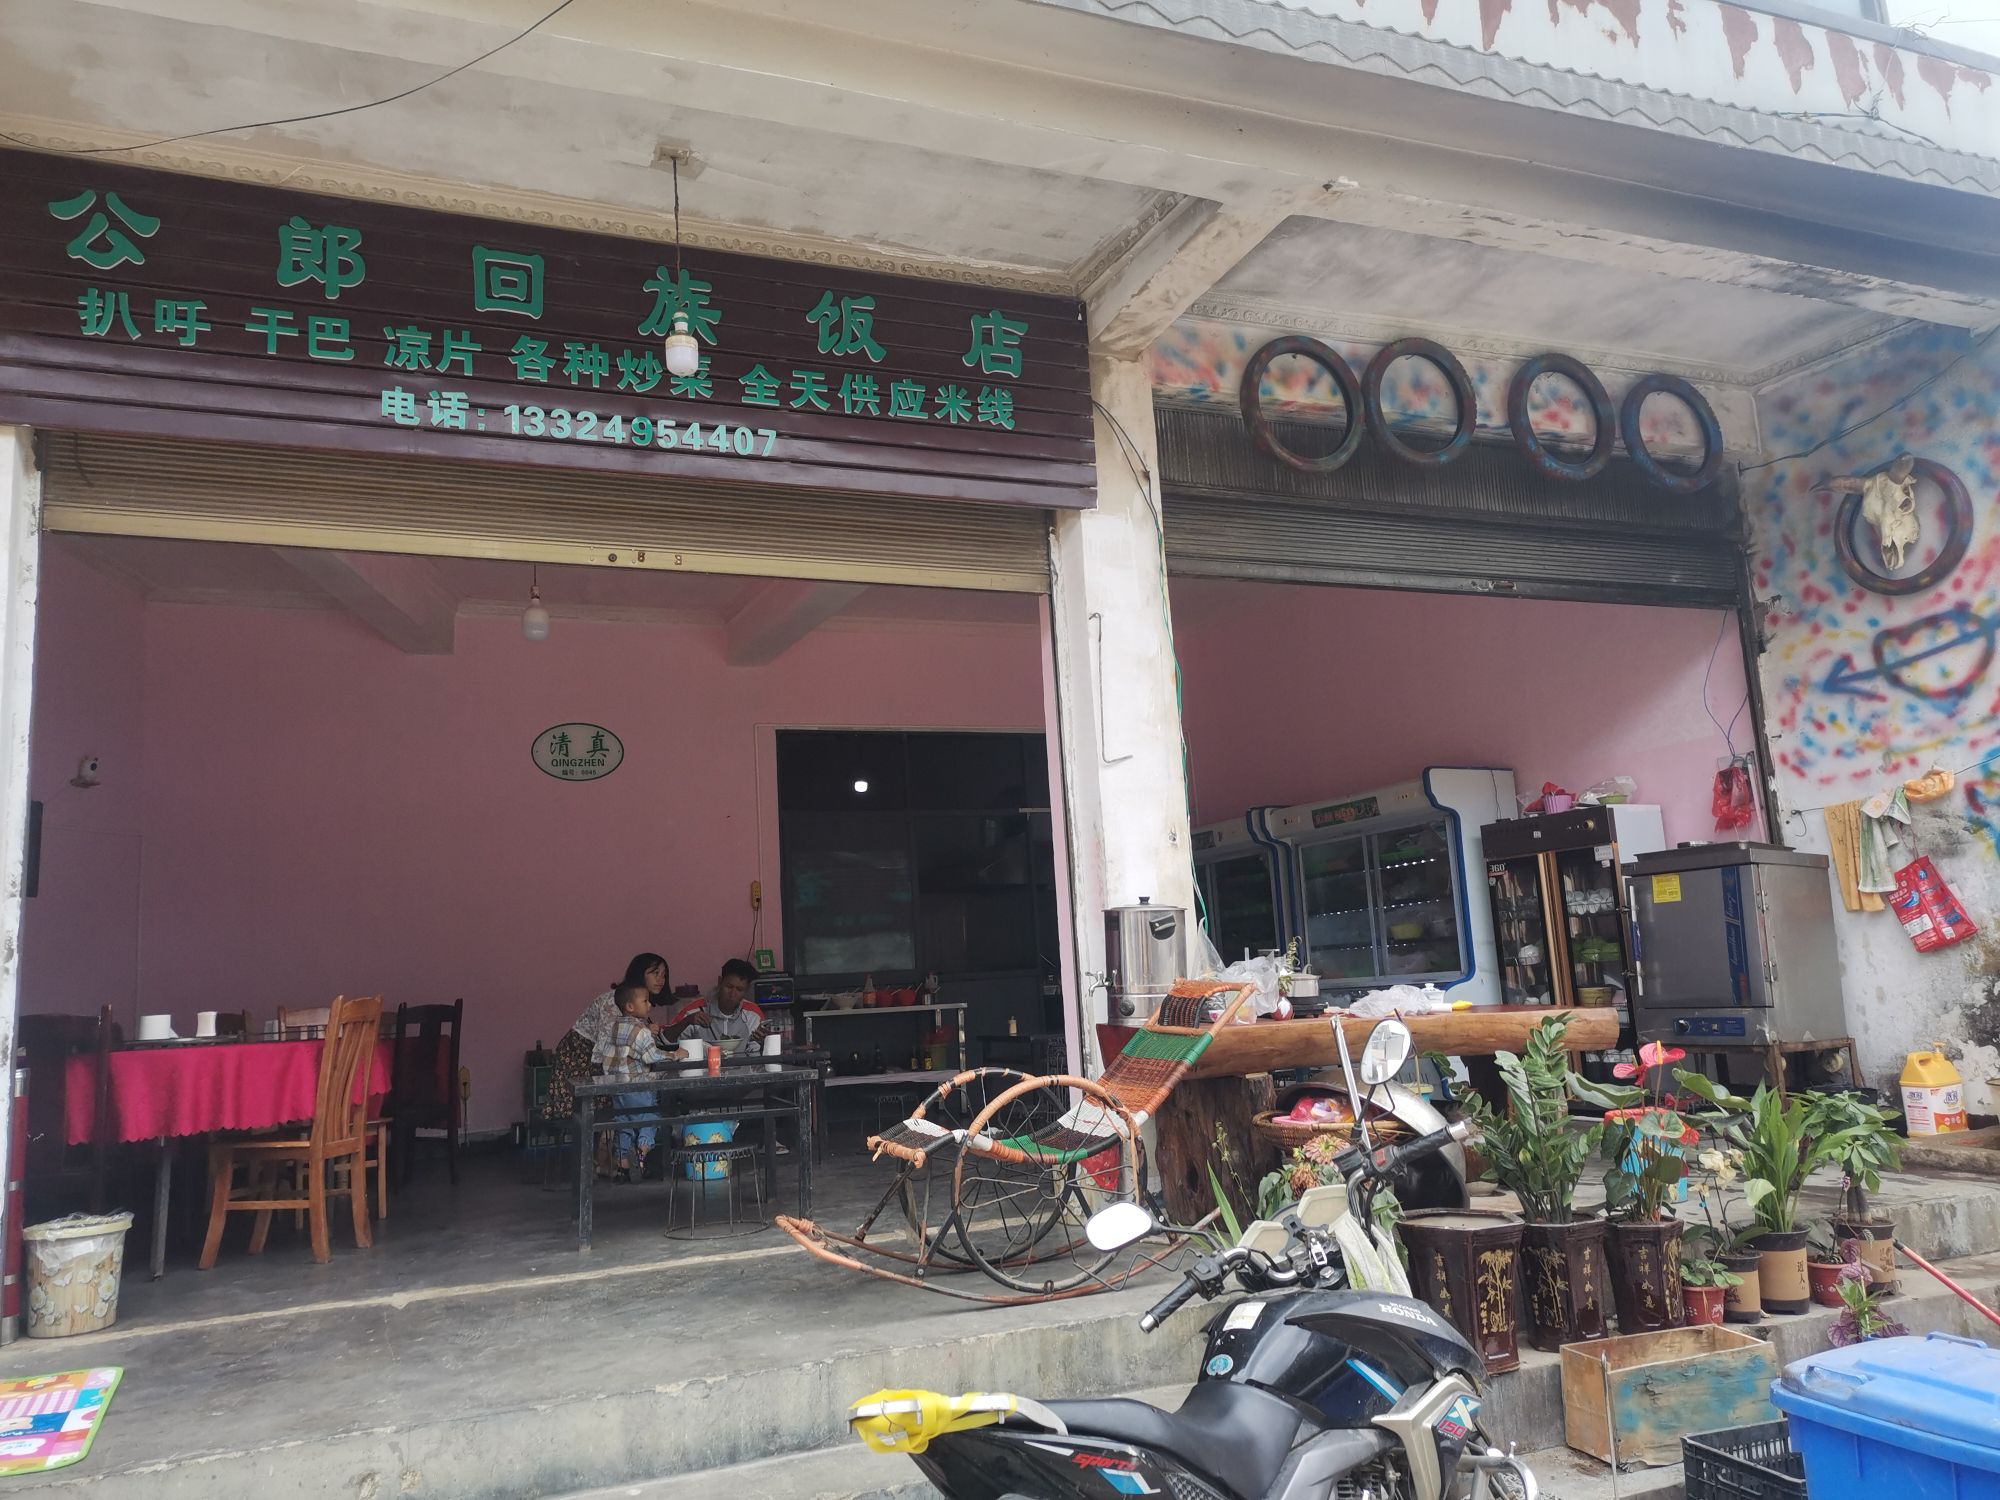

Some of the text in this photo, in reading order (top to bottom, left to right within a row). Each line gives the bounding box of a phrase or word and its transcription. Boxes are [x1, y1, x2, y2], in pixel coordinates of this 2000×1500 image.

[47, 188, 1030, 378] 公郎回族饭店
[244, 306, 355, 361] 干巴
[382, 324, 483, 377] 凉片
[737, 363, 1017, 431] 全天供应米线
[549, 730, 610, 758] 清真
[551, 758, 605, 768] QINGZHEN
[1378, 1303, 1439, 1328] HONDA
[1438, 1419, 1466, 1440] 150
